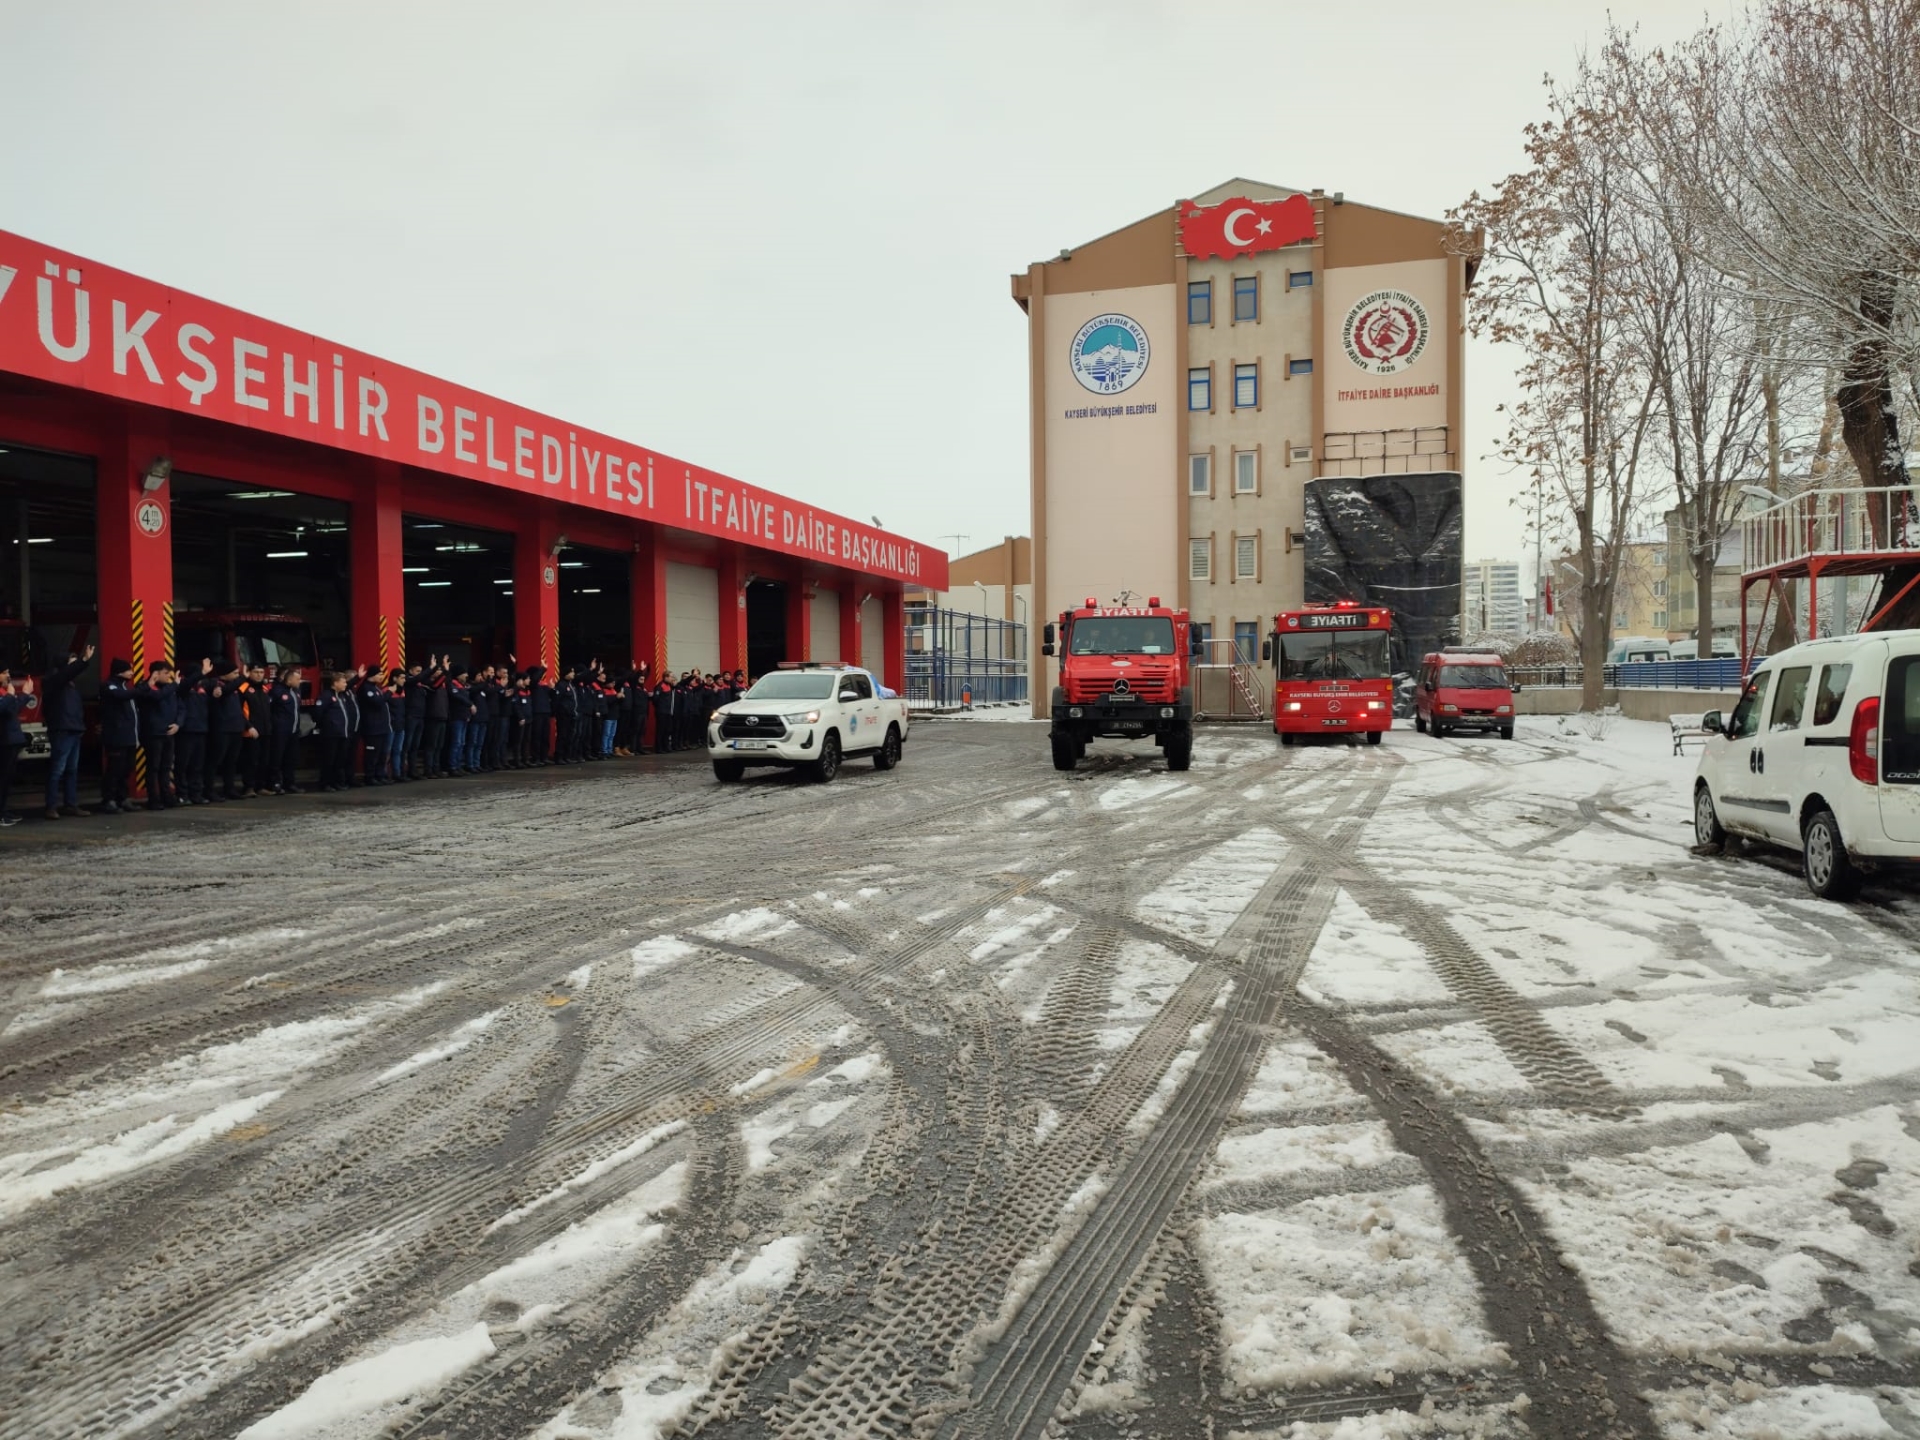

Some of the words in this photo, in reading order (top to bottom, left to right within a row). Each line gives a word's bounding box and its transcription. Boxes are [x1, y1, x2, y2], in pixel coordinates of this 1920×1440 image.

[1376, 365, 1396, 373] 1926
[1099, 380, 1123, 391] 1869
[1338, 388, 1367, 402] İTFAİYE
[1369, 386, 1392, 399] DAİRE
[1393, 383, 1439, 400] BAŞKANLIĞI
[1064, 406, 1089, 419] KAYSERİ
[1089, 404, 1124, 419] BÜYÜKŞEHİR
[1125, 402, 1157, 415] BELEDİYESİ
[417, 394, 654, 509] BELEDİYESİ
[685, 469, 775, 540] İTFAİYE
[783, 510, 836, 556] DAİRE
[842, 528, 920, 577] BAŞKANLIĞI
